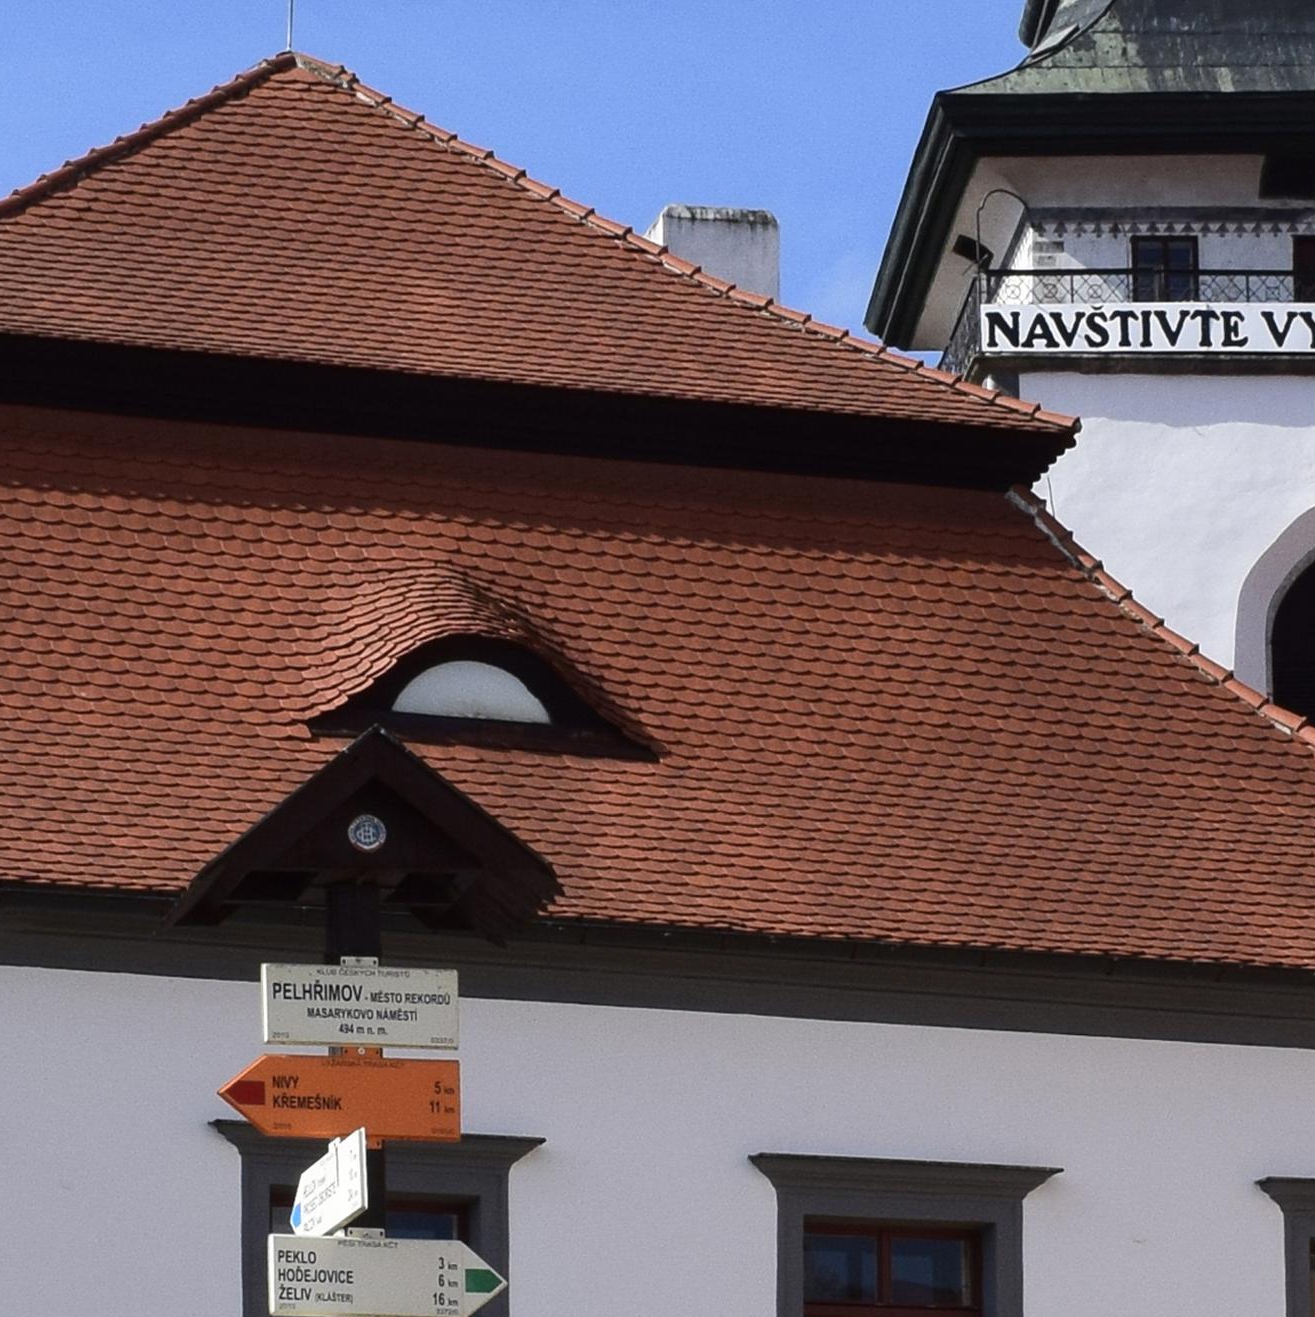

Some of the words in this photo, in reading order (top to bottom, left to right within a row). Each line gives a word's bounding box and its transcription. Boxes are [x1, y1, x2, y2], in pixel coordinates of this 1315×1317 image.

[985, 304, 1249, 348] NAVŠTIVTE
[272, 980, 363, 1001] PELHŘIMOV
[370, 990, 403, 1004] MĚSTO
[404, 991, 451, 1005] REKORDŮ
[307, 1007, 374, 1020] MASARYKOVO
[376, 1006, 418, 1021] NÁMĚSTÍ
[338, 1024, 354, 1034] 494
[356, 1026, 365, 1034] m
[272, 1076, 300, 1089] NIVY
[434, 1081, 442, 1095] 5
[272, 1094, 342, 1110] KŘEMEŠNÍK
[429, 1101, 441, 1113] 11
[277, 1250, 317, 1264] PEKLO
[438, 1257, 445, 1270] 3
[447, 1262, 458, 1271] km
[438, 1274, 445, 1288] 6
[447, 1279, 459, 1288] km
[278, 1286, 312, 1301] ŽELIV
[432, 1293, 445, 1307] 16
[448, 1298, 459, 1307] km
